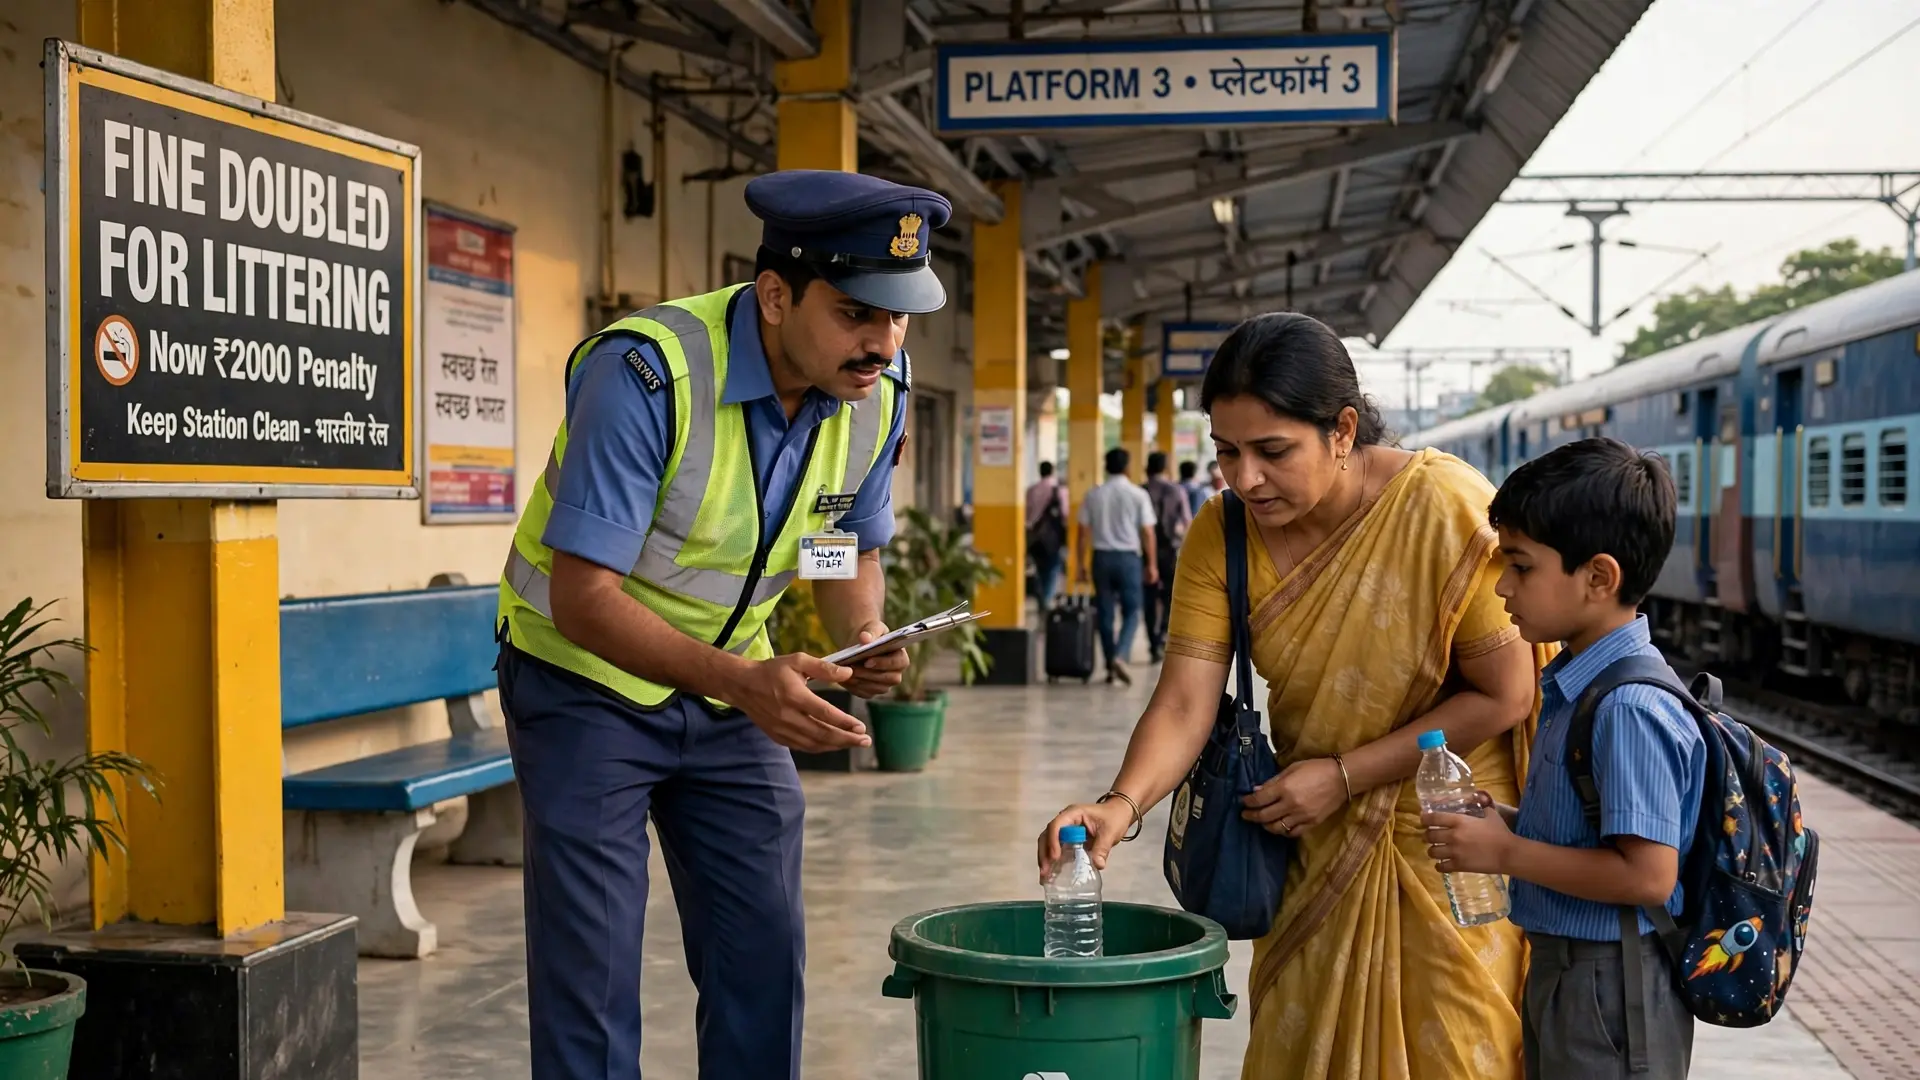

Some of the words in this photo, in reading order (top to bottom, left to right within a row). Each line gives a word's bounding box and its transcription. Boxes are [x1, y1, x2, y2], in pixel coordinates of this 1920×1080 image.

[965, 67, 1140, 103] PLATFORM
[1152, 66, 1171, 98] 3
[1209, 54, 1331, 96] प्लेटफॉर्म
[1342, 61, 1361, 94] 3
[104, 119, 206, 215] FINE
[220, 148, 389, 252] DOUBLED
[99, 220, 189, 308] FOR
[203, 238, 390, 335] LITTERING
[149, 329, 207, 378] Now
[213, 337, 291, 385] ₹2000
[298, 347, 377, 400] Penalty
[440, 352, 477, 382] स्वच्छ
[479, 346, 498, 385] रेल
[127, 402, 176, 443] Keep
[182, 406, 248, 440] Station
[253, 409, 300, 442] Clean
[315, 411, 365, 445] भारतीय
[368, 413, 389, 447] रेल
[434, 391, 470, 421] स्वच्छ
[475, 398, 506, 423] भारत
